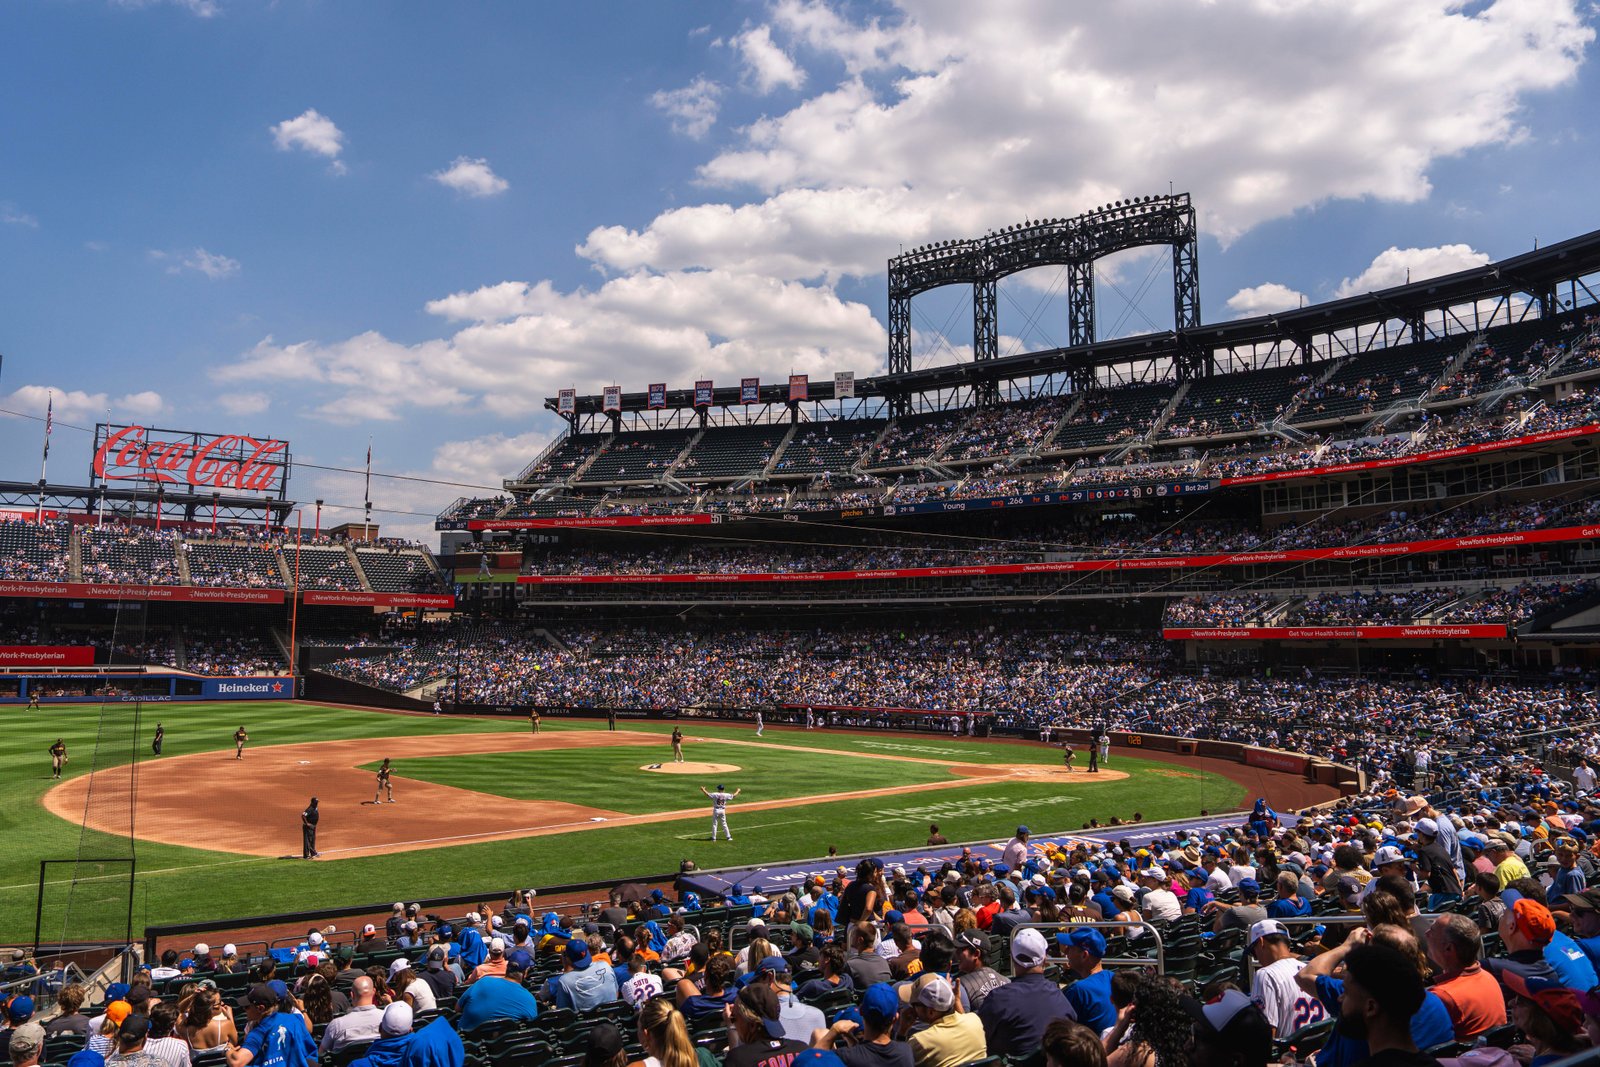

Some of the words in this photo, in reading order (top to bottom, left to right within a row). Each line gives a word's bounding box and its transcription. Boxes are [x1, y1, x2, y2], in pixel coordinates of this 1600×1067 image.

[1124, 489, 1130, 497] 2
[1185, 484, 1197, 492] Bot
[1196, 483, 1209, 491] 2nd
[942, 503, 966, 511] Young
[1007, 497, 1024, 505] .266
[1072, 492, 1083, 500] 29
[783, 513, 799, 522] King
[841, 509, 863, 519] pitches
[867, 508, 875, 516] 16
[1582, 528, 1595, 537] Get
[1459, 535, 1524, 548] NewYork-Presbyterian
[1360, 547, 1378, 556] Health
[91, 587, 172, 598] NewYork-Presbyterian
[193, 590, 268, 601] NewYork-Presbyterian
[315, 594, 375, 603] NewYork-Presbyterian
[393, 596, 449, 605] NewYork-Presbyterian
[1404, 627, 1470, 637] NewYork-Presbyterian
[218, 682, 269, 694] Heineken
[633, 977, 649, 988] SOTO
[634, 983, 656, 1001] 22
[1294, 996, 1325, 1033] 22
[264, 1055, 284, 1066] DELTA
